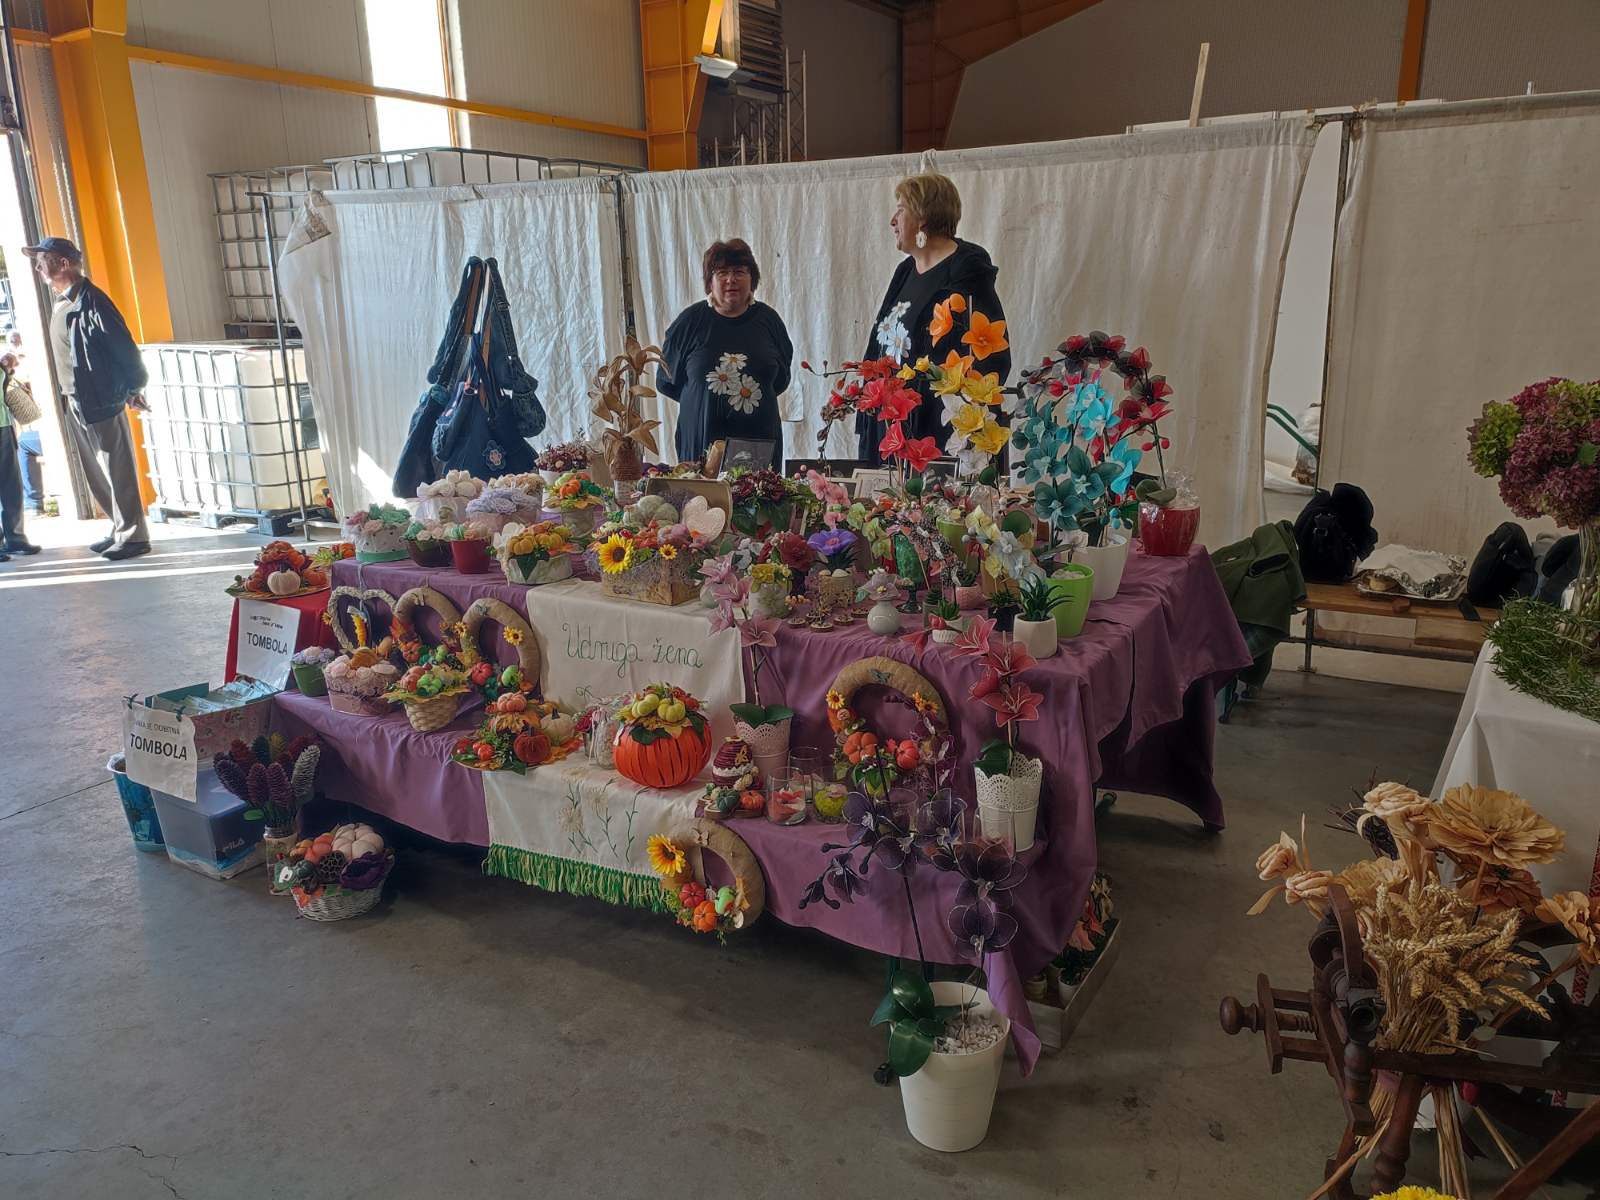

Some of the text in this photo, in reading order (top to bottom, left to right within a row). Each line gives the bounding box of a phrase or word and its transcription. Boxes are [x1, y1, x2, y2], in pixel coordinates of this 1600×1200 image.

[246, 632, 288, 655] TOMBOLA
[562, 623, 704, 678] Udruga žena
[130, 733, 187, 760] TOMBOLA
